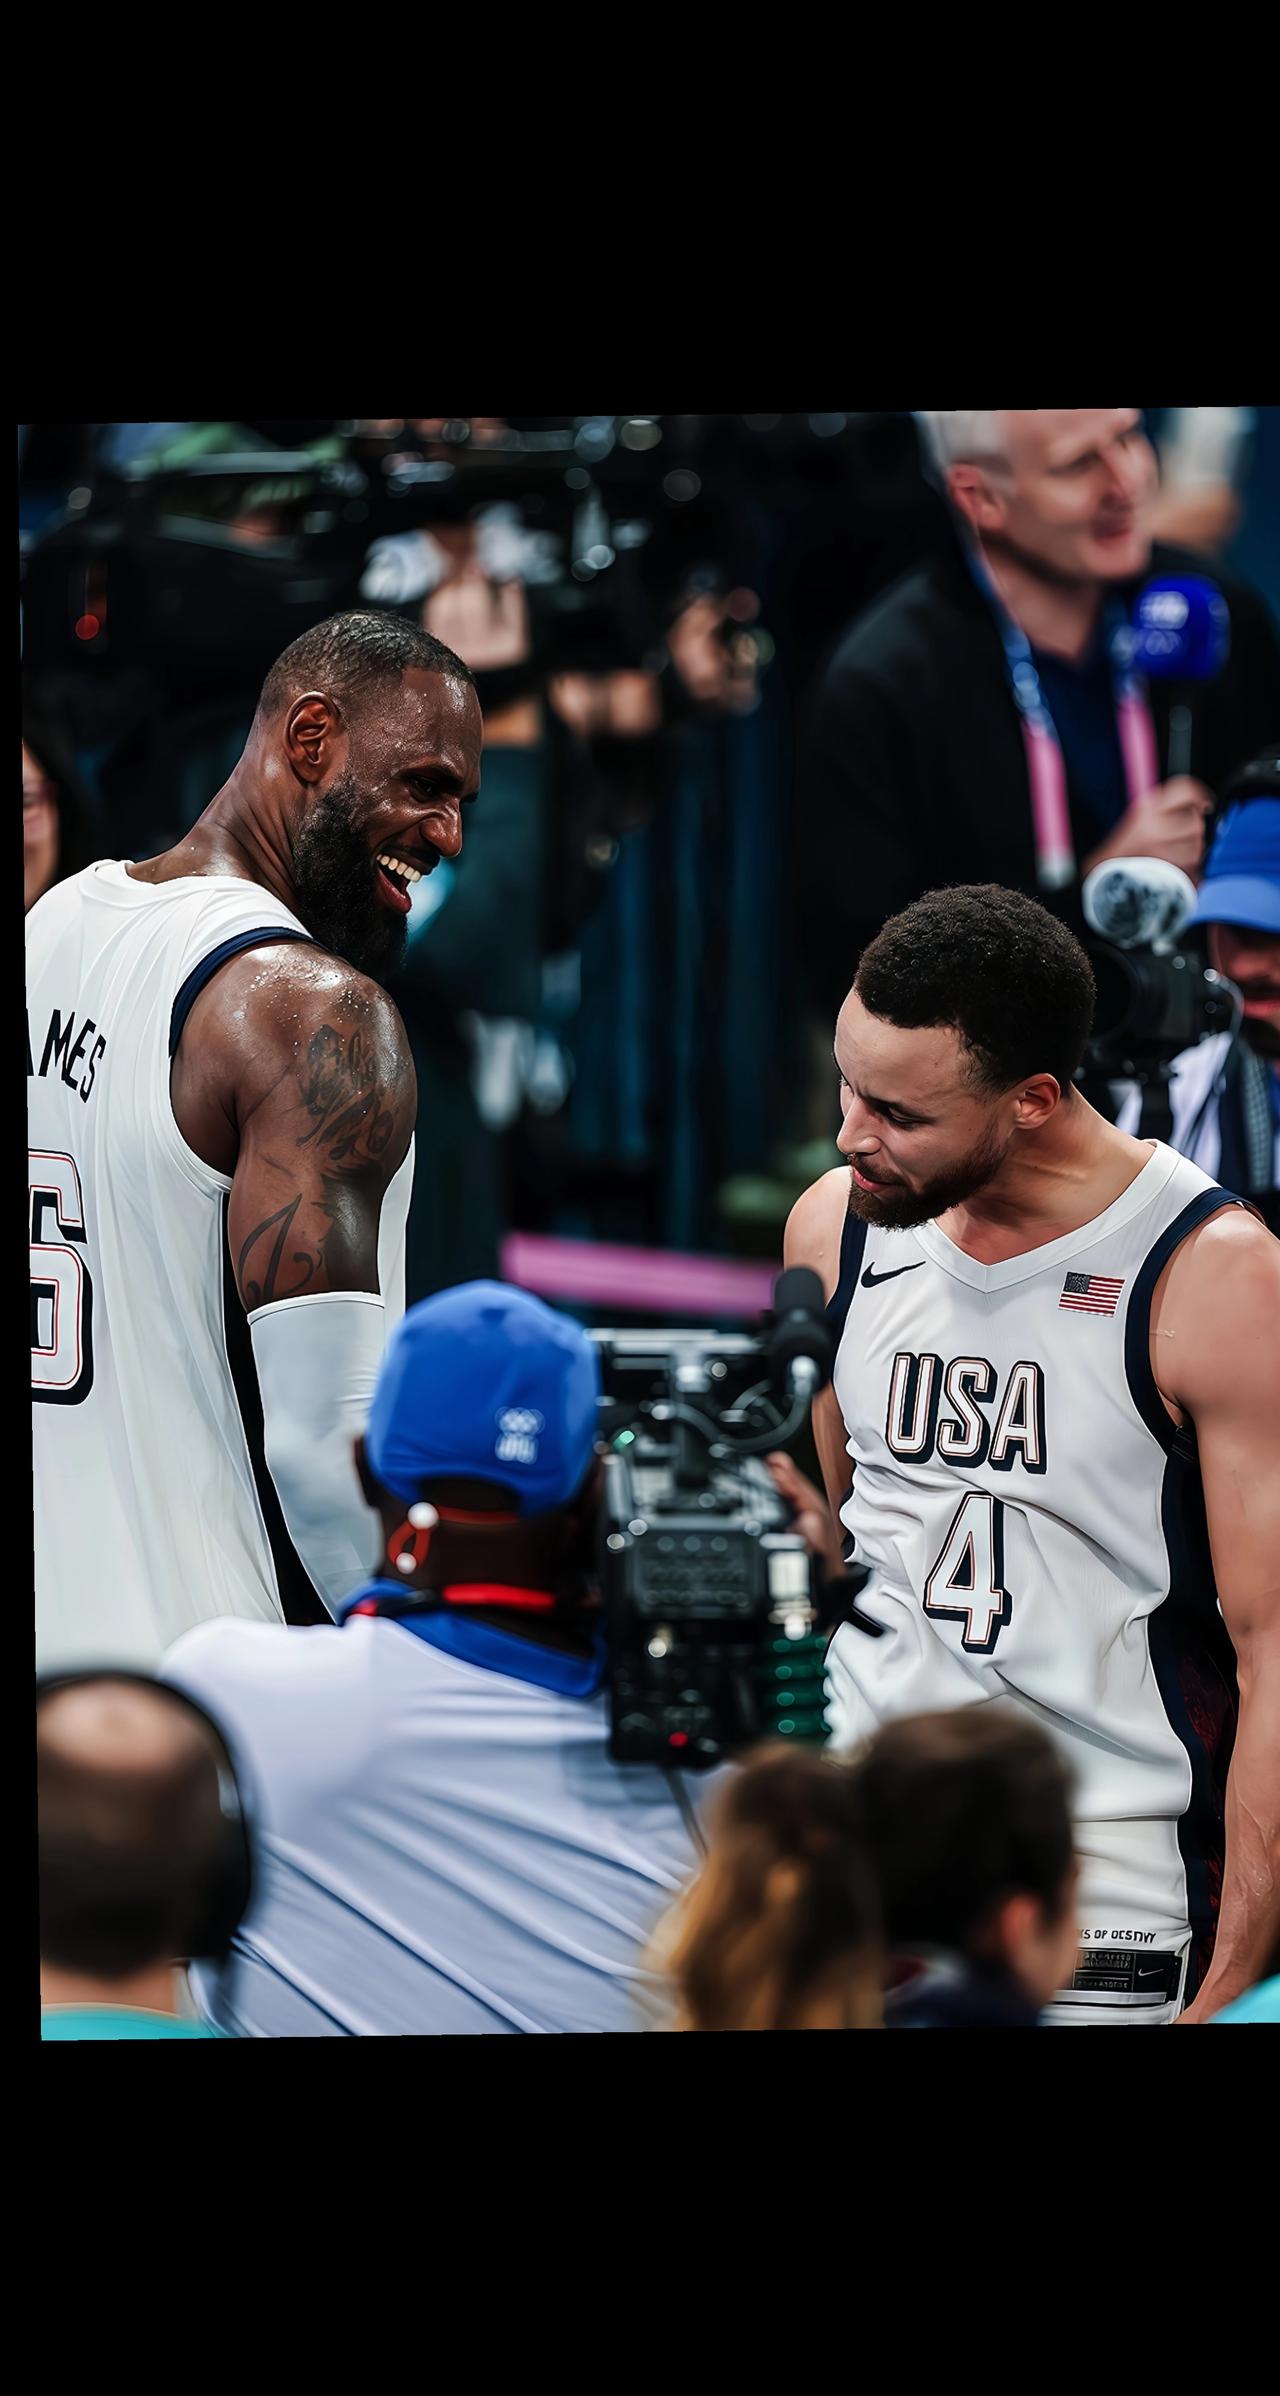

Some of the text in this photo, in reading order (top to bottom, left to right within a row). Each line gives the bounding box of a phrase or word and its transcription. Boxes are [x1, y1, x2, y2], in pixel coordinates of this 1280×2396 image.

[28, 1148, 95, 1406] 6
[885, 1352, 1048, 1475] USA
[923, 1490, 1013, 1655] 4
